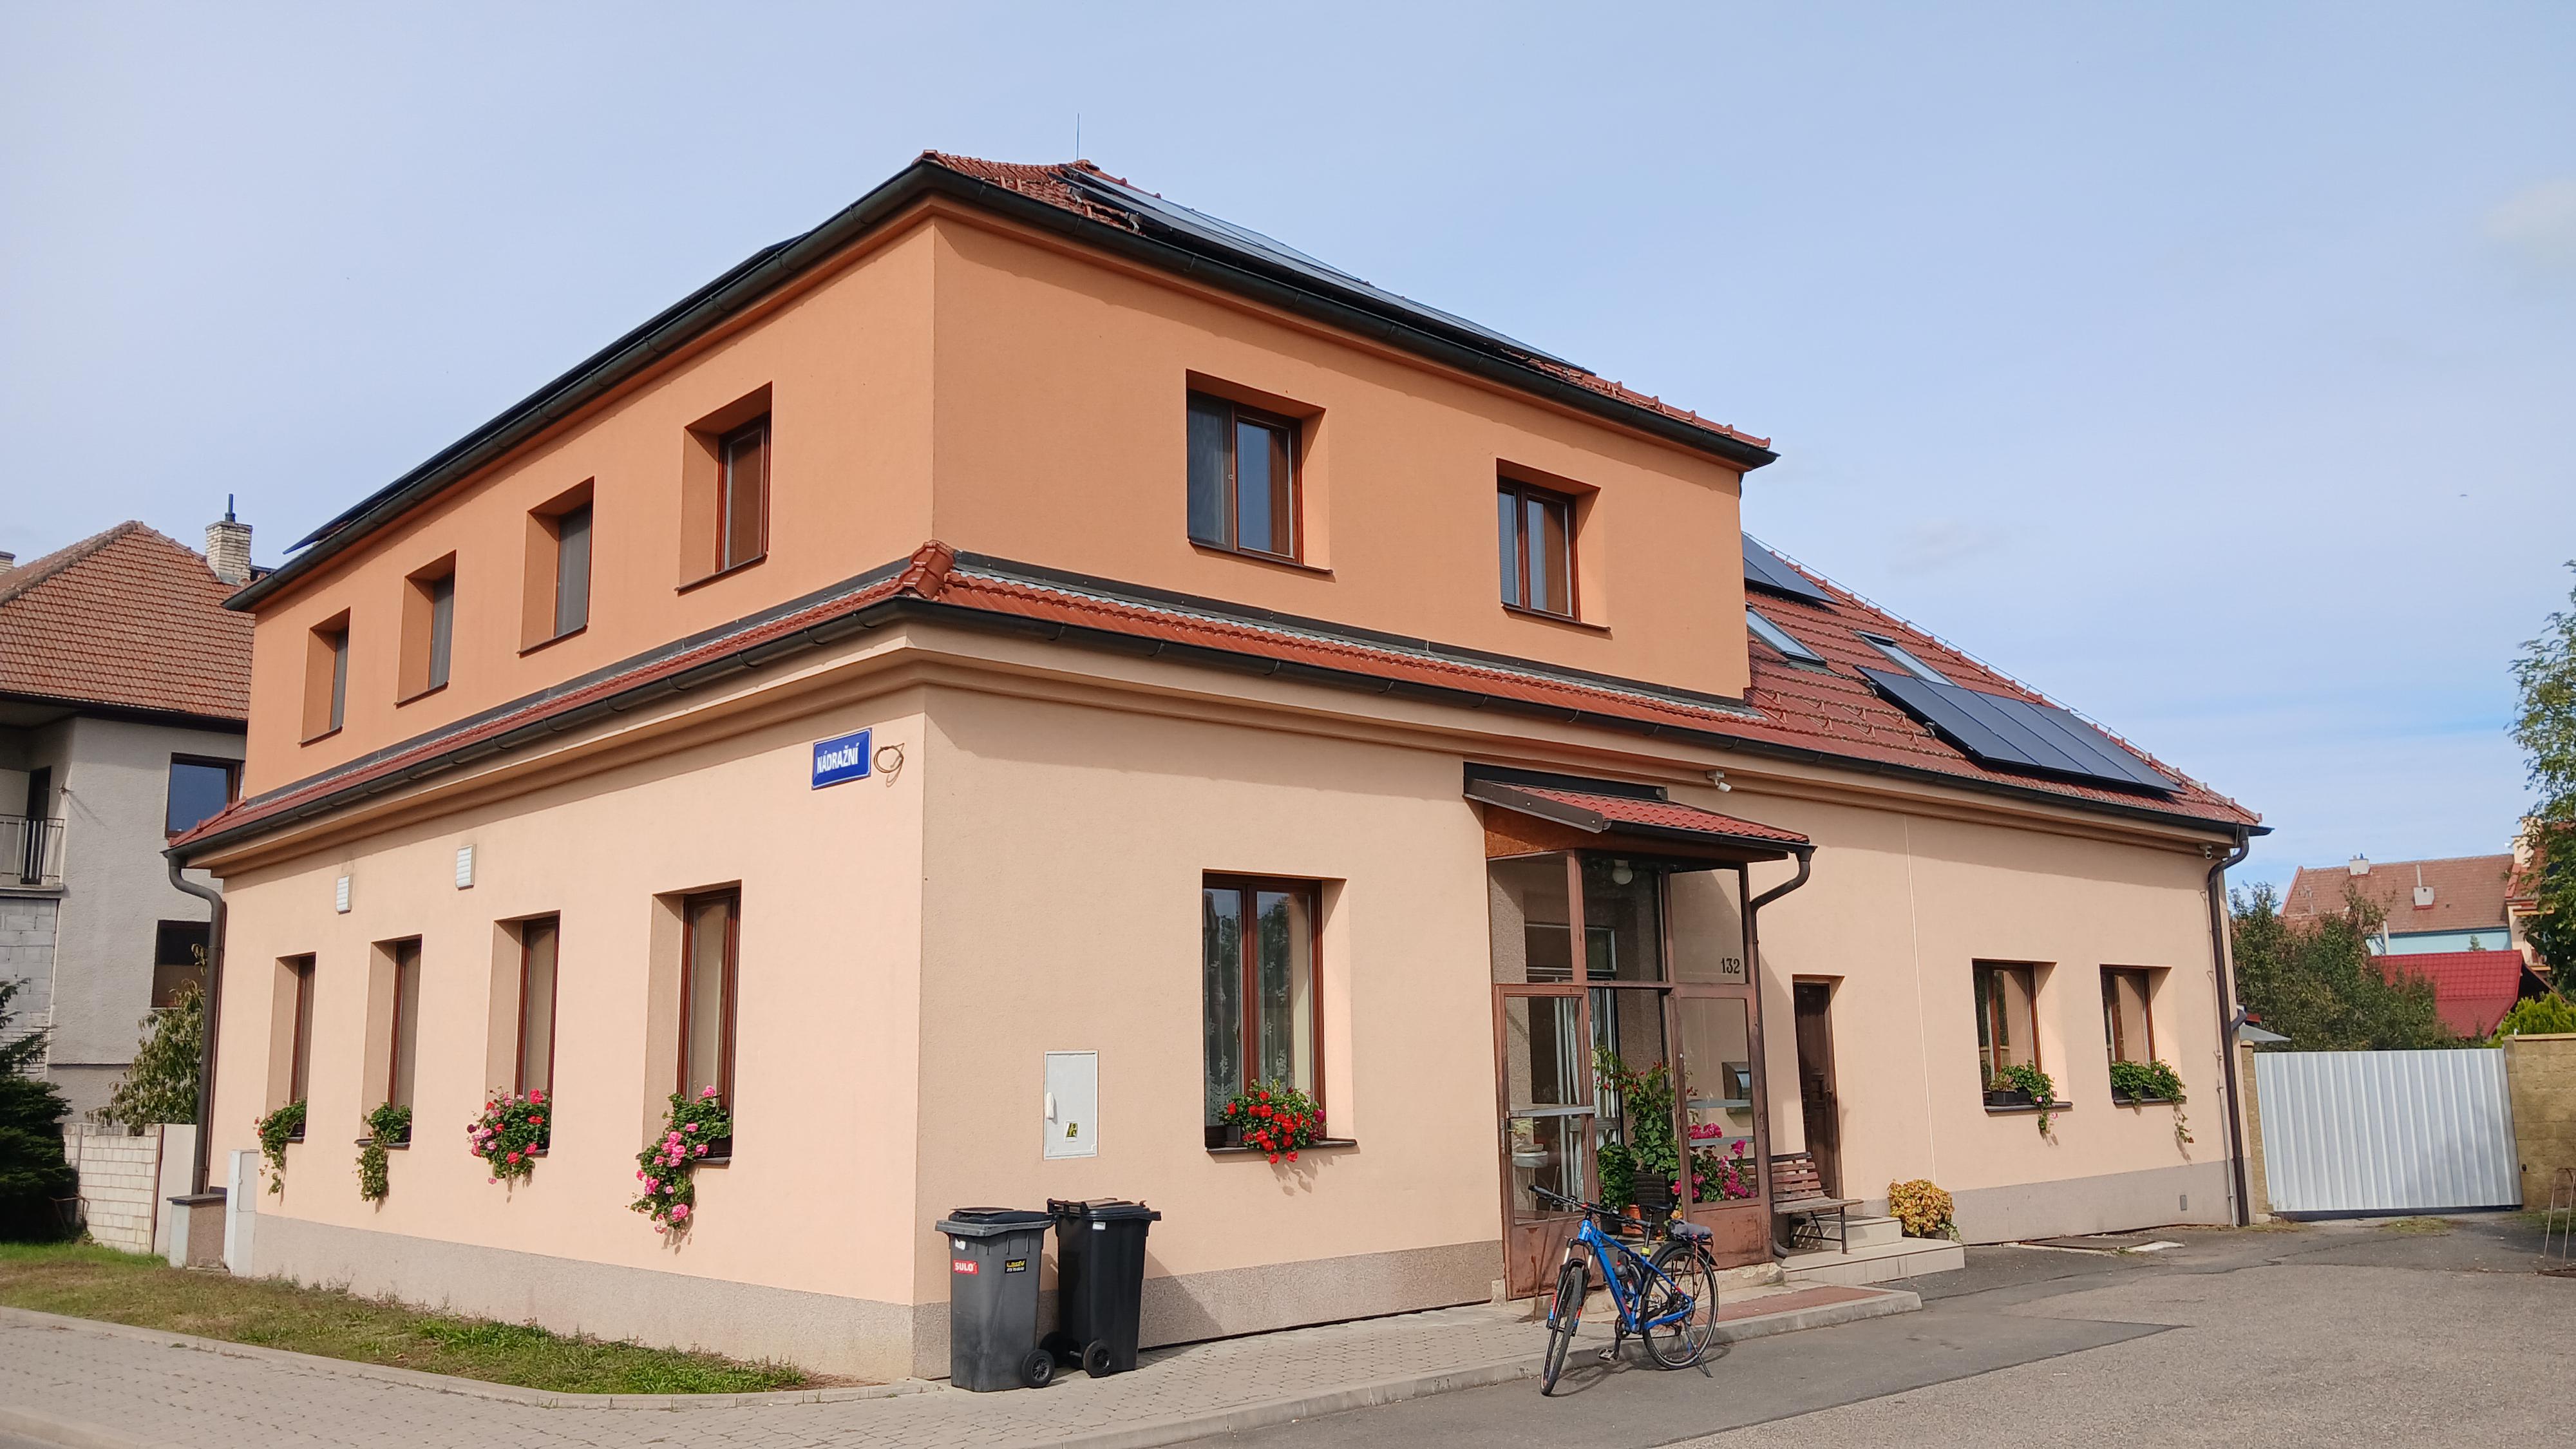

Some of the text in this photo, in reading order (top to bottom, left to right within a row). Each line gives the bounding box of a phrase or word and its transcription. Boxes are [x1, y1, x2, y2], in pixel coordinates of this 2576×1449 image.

[817, 742, 860, 774] NÁDRAŽNÍ
[1721, 957, 1740, 974] 132
[954, 1262, 974, 1272] SULO
